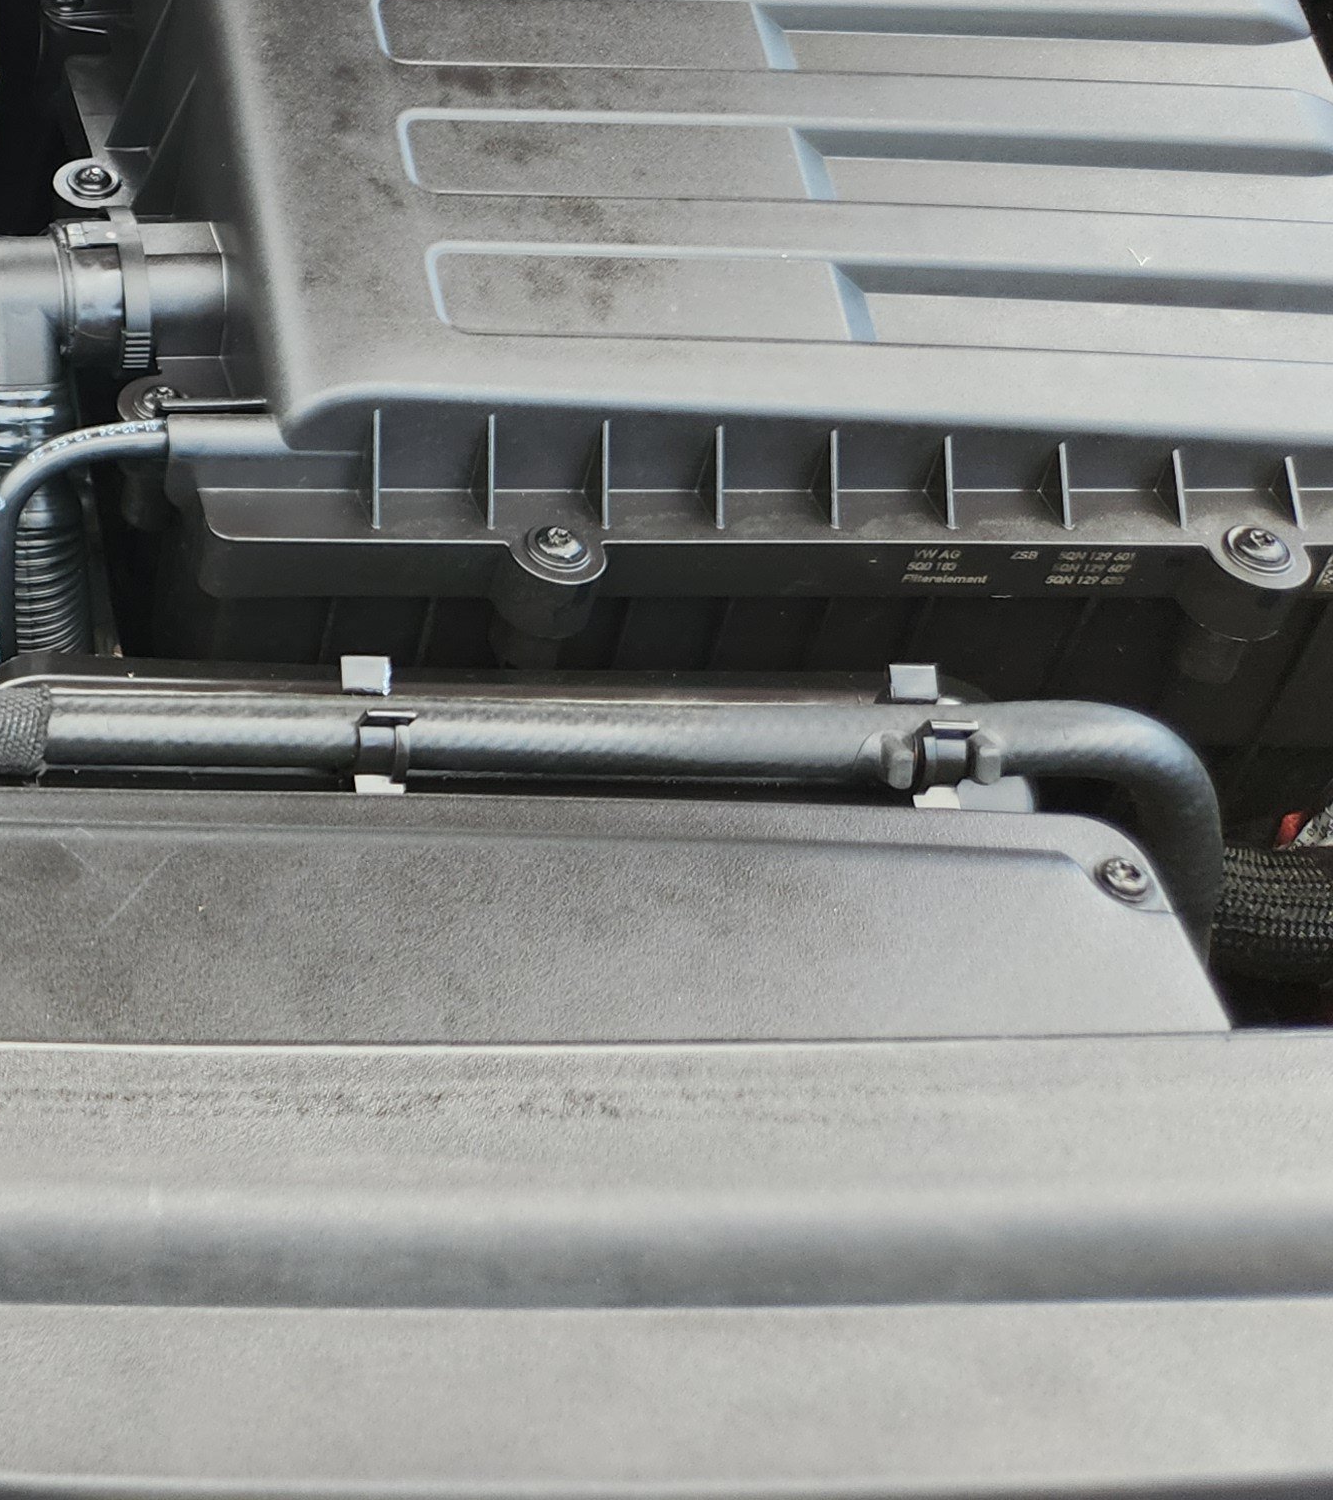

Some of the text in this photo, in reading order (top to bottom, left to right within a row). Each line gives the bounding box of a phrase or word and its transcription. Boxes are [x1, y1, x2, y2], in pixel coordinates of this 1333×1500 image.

[914, 550, 961, 560] VW AG
[901, 574, 988, 585] Filterelement
[1076, 575, 1100, 585] 129
